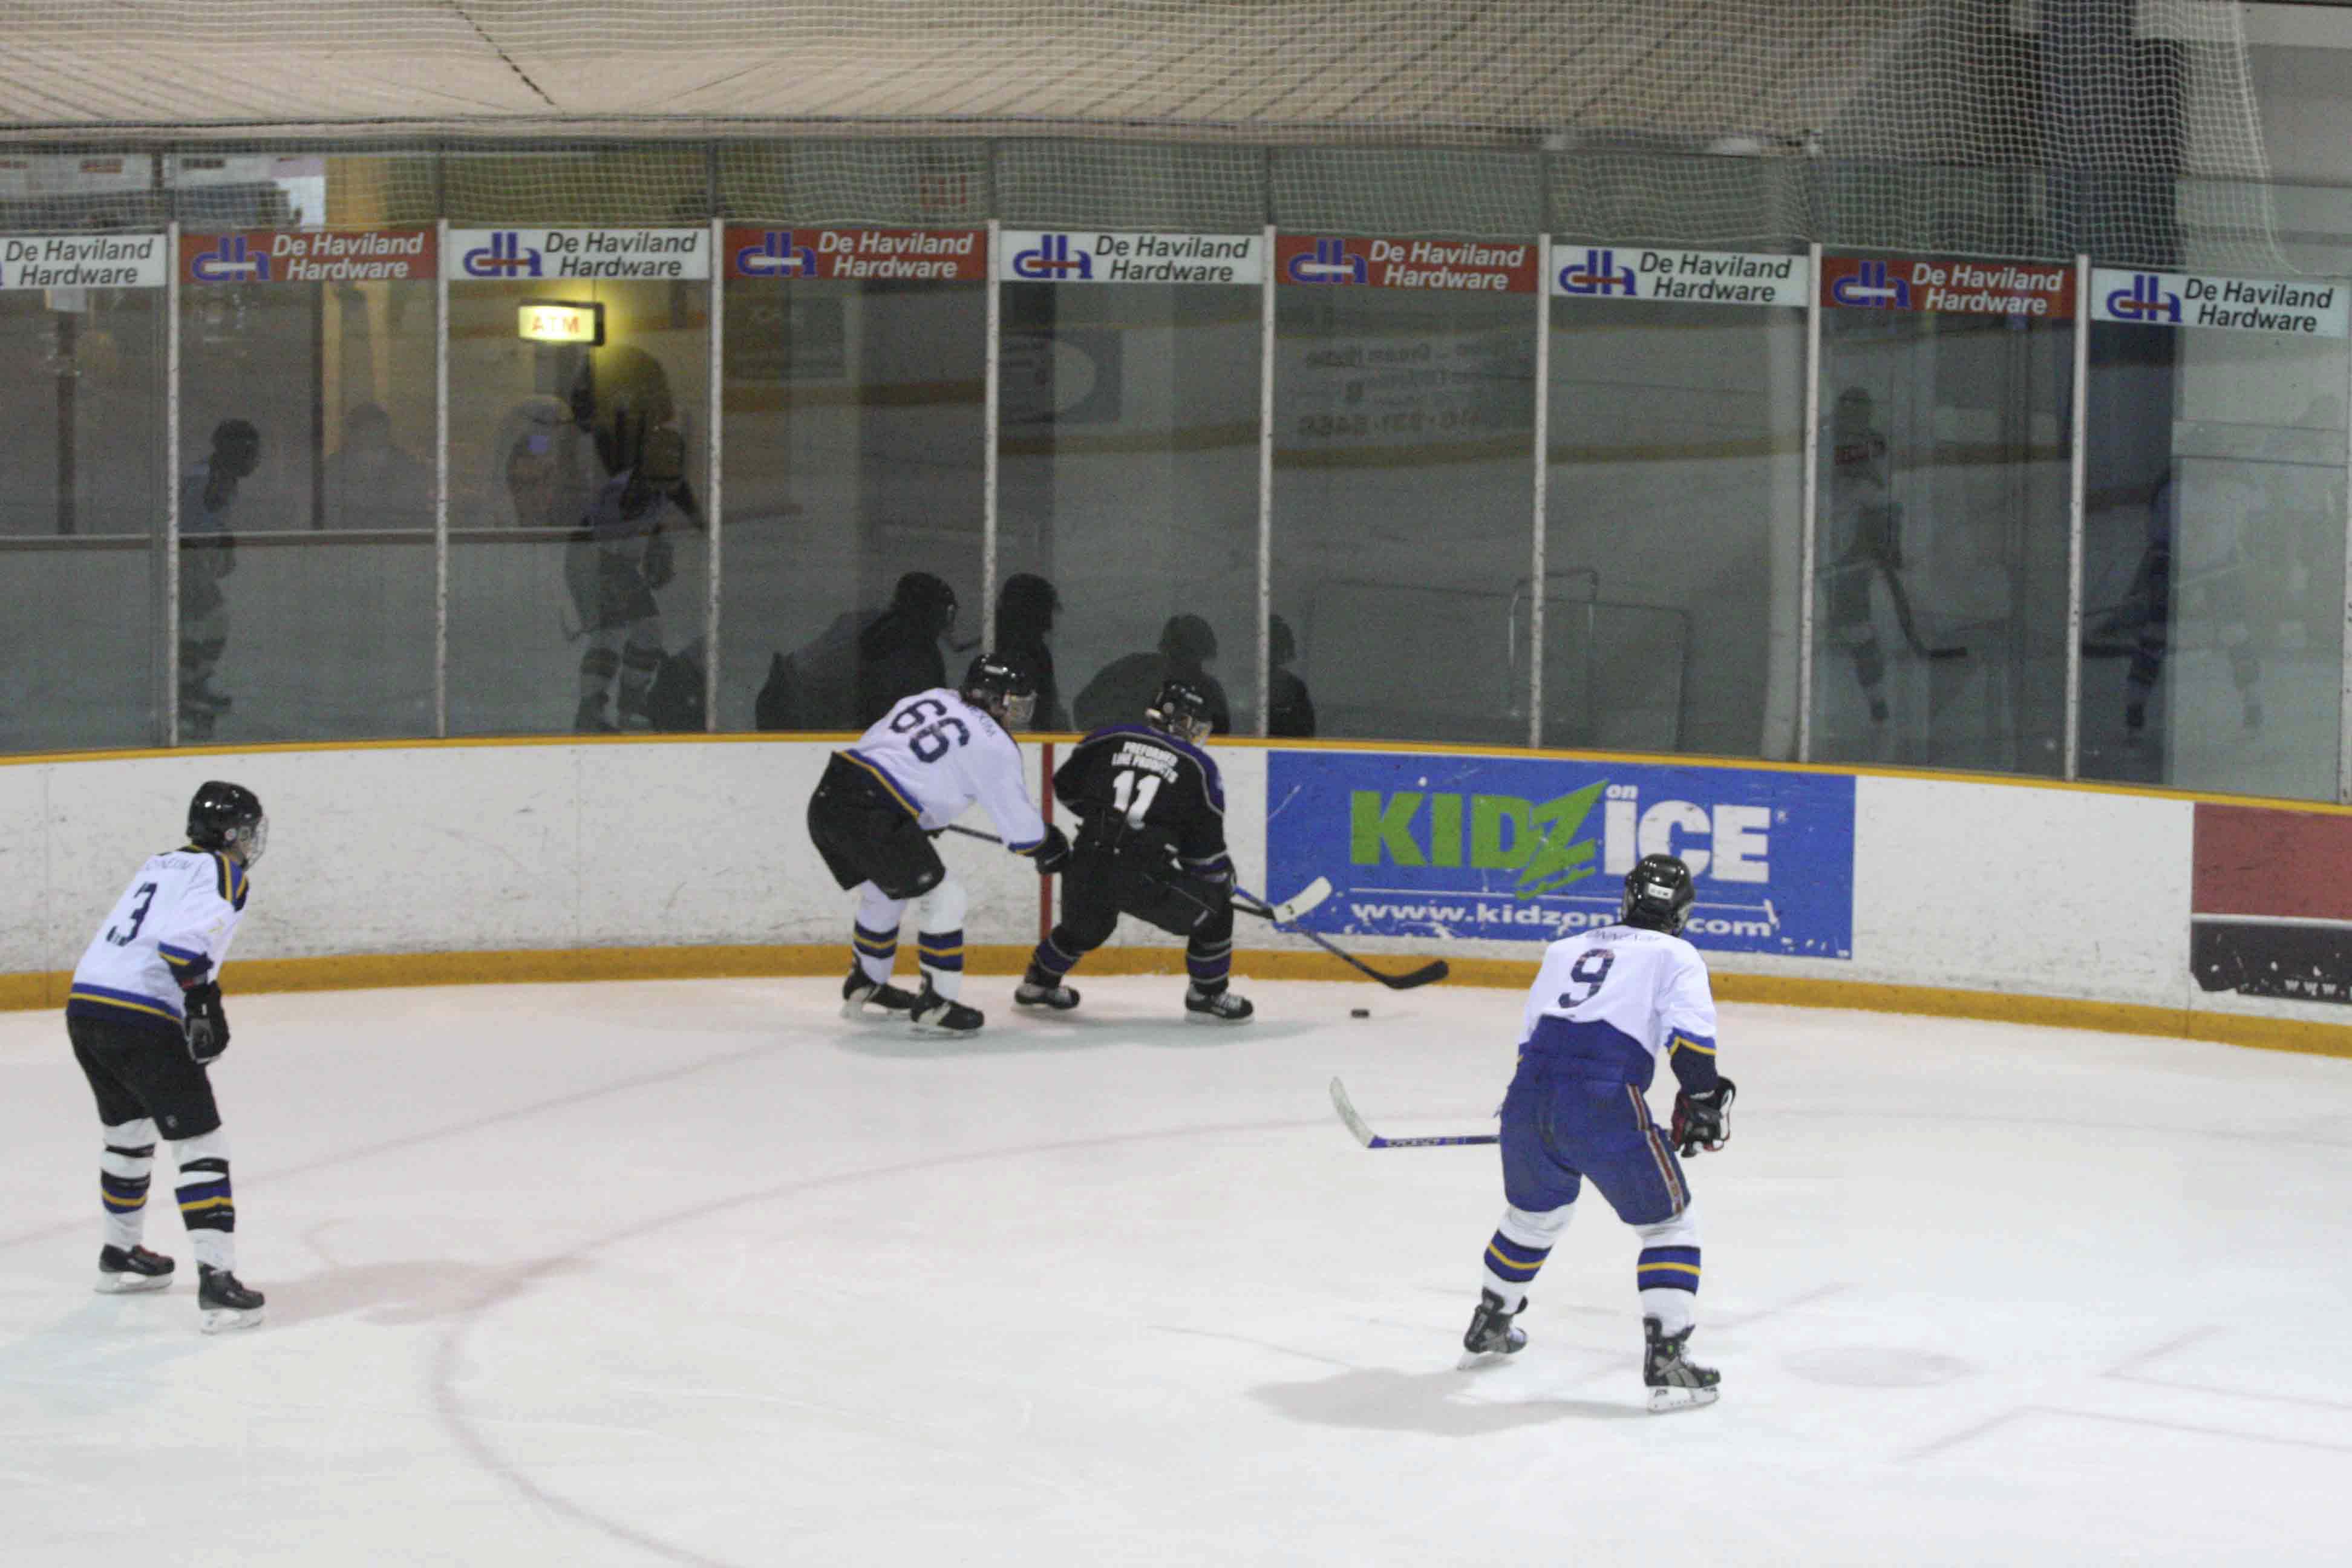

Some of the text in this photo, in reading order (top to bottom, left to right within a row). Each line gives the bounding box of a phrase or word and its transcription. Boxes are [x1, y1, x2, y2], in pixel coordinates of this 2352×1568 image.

[5, 238, 153, 261] De Haviland
[272, 232, 424, 256] De Haviland
[545, 232, 697, 253] De Haviland
[818, 232, 973, 254] De Haviland
[1096, 235, 1250, 259] De Haviland
[1370, 240, 1525, 267] De Haviland
[20, 264, 138, 286] Hardware
[286, 259, 409, 281] Hardware
[559, 257, 682, 277] Hardware
[832, 256, 958, 278] Hardware
[1109, 260, 1233, 282] Hardware
[1384, 264, 1508, 290] Hardware
[1640, 252, 1792, 279] De Haviland
[1912, 263, 2063, 292] De Haviland
[1653, 276, 1776, 302] Hardware
[1926, 288, 2047, 315] Hardware
[2184, 278, 2333, 309] De Haviland
[532, 315, 580, 333] ATM
[2198, 304, 2317, 332] Hardware
[890, 698, 971, 764] 66
[1112, 769, 1161, 830] 11
[1351, 779, 1610, 900] KIDZ
[1606, 784, 1638, 799] on
[106, 881, 158, 947] 3
[1558, 947, 1616, 1009] 9
